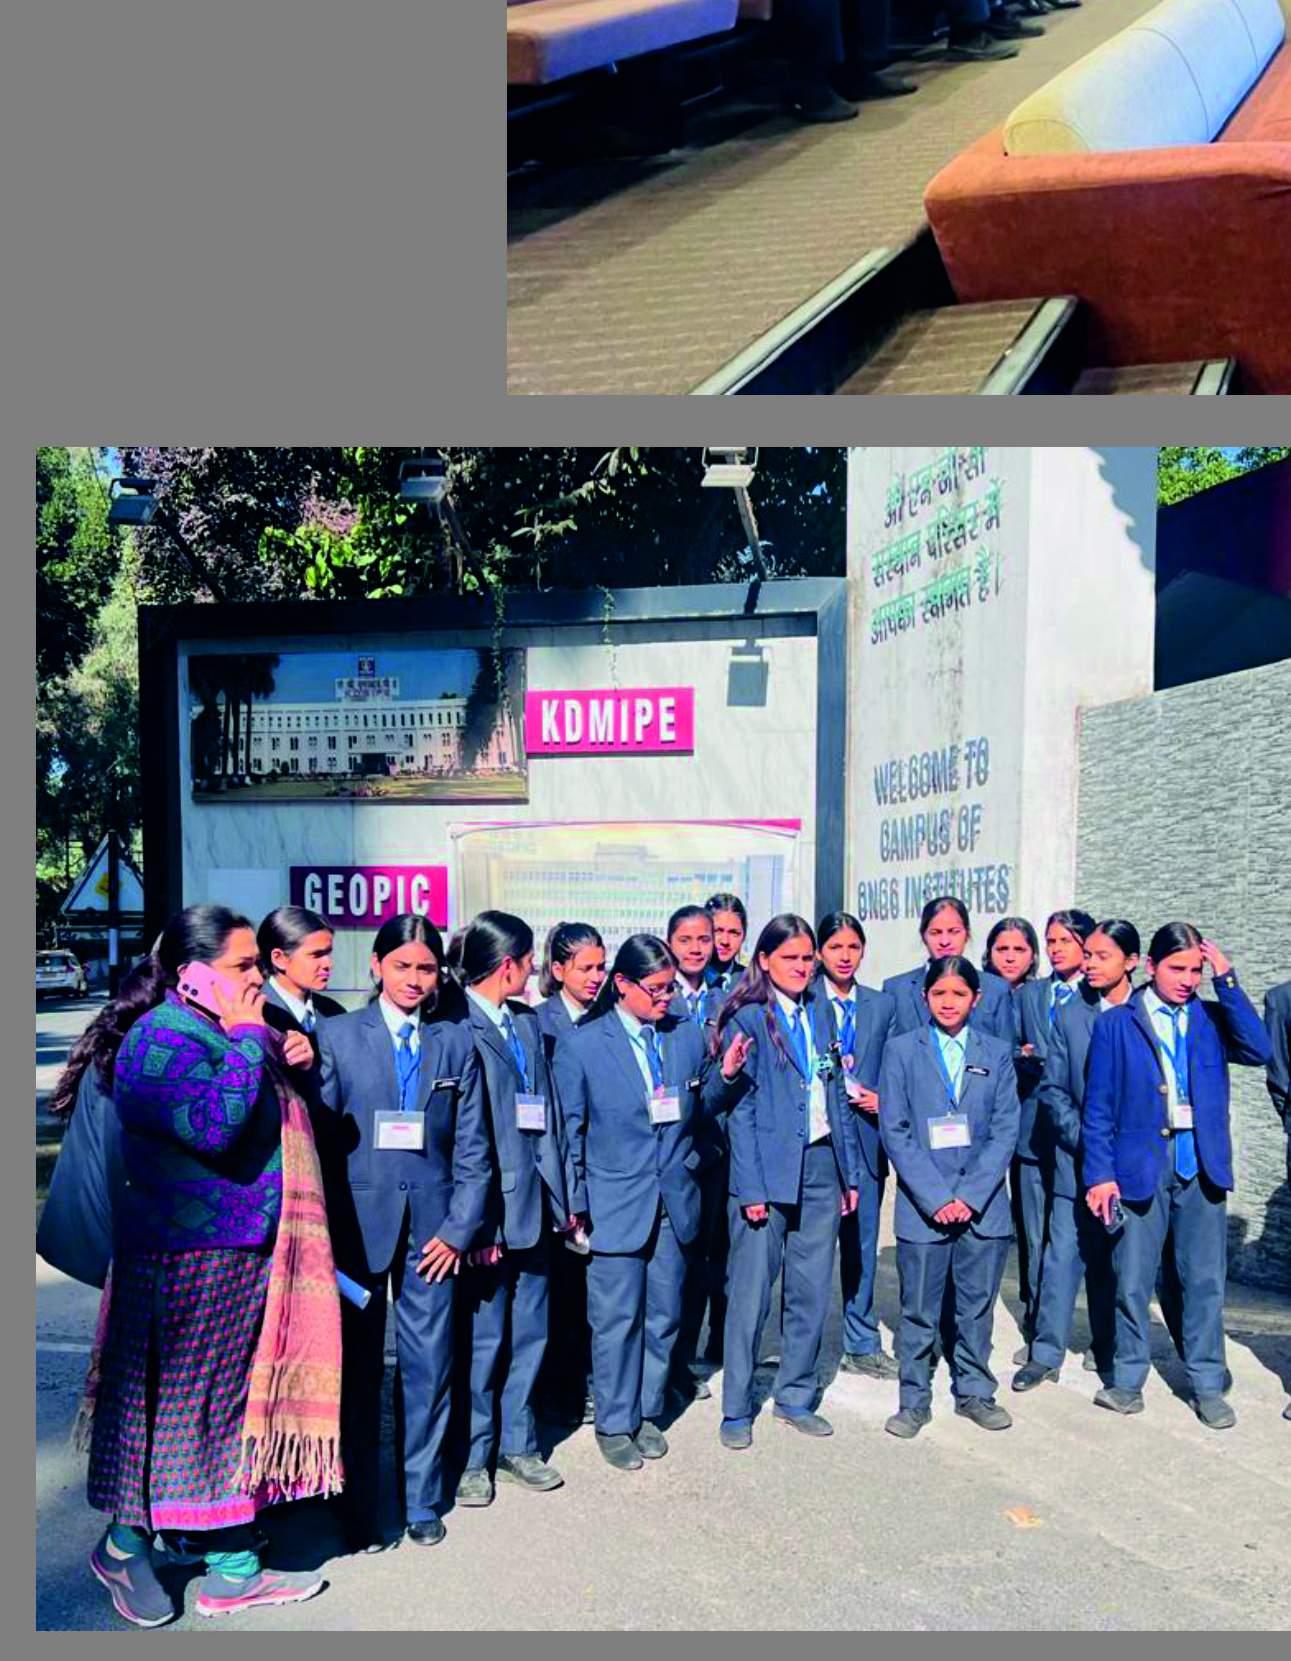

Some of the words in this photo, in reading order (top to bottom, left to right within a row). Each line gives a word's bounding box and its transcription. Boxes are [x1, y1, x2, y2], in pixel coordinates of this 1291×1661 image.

[541, 696, 677, 745] KDMIPE
[873, 744, 960, 806] WELCOME
[964, 736, 990, 790] TO
[880, 808, 952, 863] CAMPUS
[957, 803, 984, 853] OF
[303, 871, 432, 917] GEOPIC
[904, 863, 1011, 919] INSTITUTES
